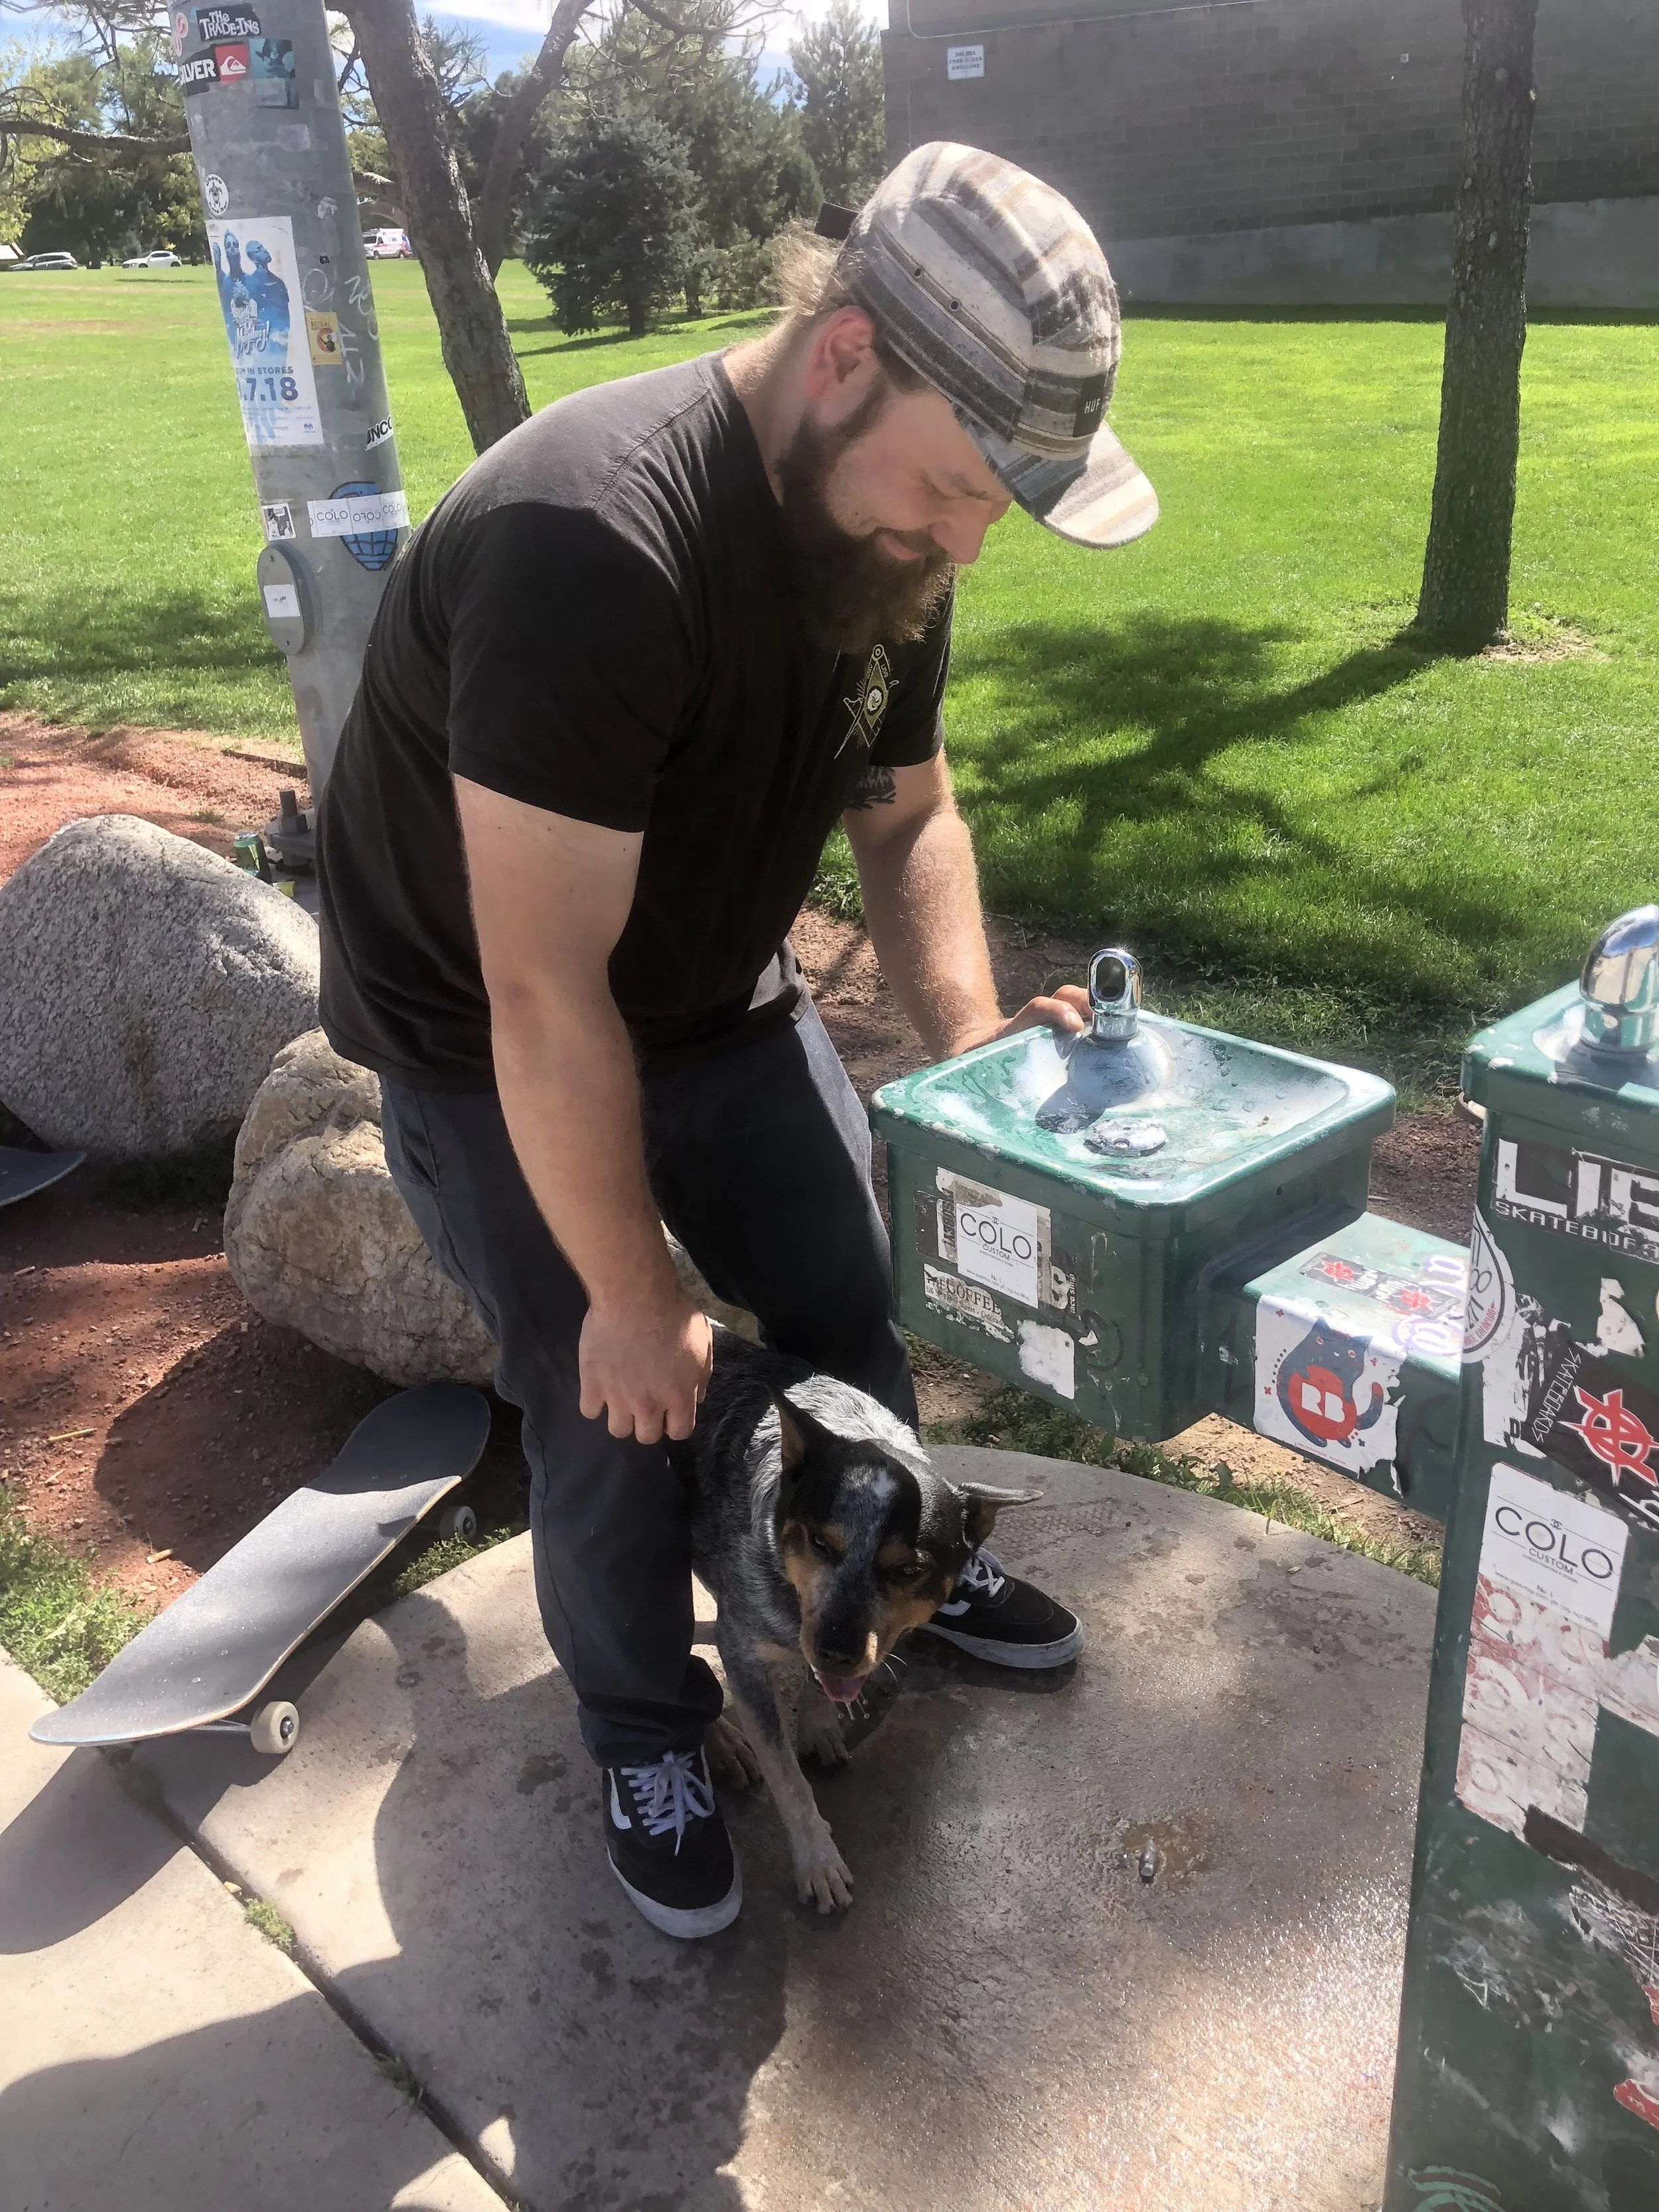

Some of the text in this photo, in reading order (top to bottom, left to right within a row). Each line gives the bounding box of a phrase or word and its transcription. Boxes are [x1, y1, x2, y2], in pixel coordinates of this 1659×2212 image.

[199, 17, 260, 40] TRADE-INS
[421, 398, 437, 414] HUF
[317, 510, 348, 521] COLO
[960, 1213, 1032, 1260] COLO
[983, 1244, 1010, 1261] CUSTOM
[946, 1278, 1001, 1315] COFFEE
[1496, 1507, 1613, 1579] COLO
[1529, 1548, 1573, 1575] CUSTOM
